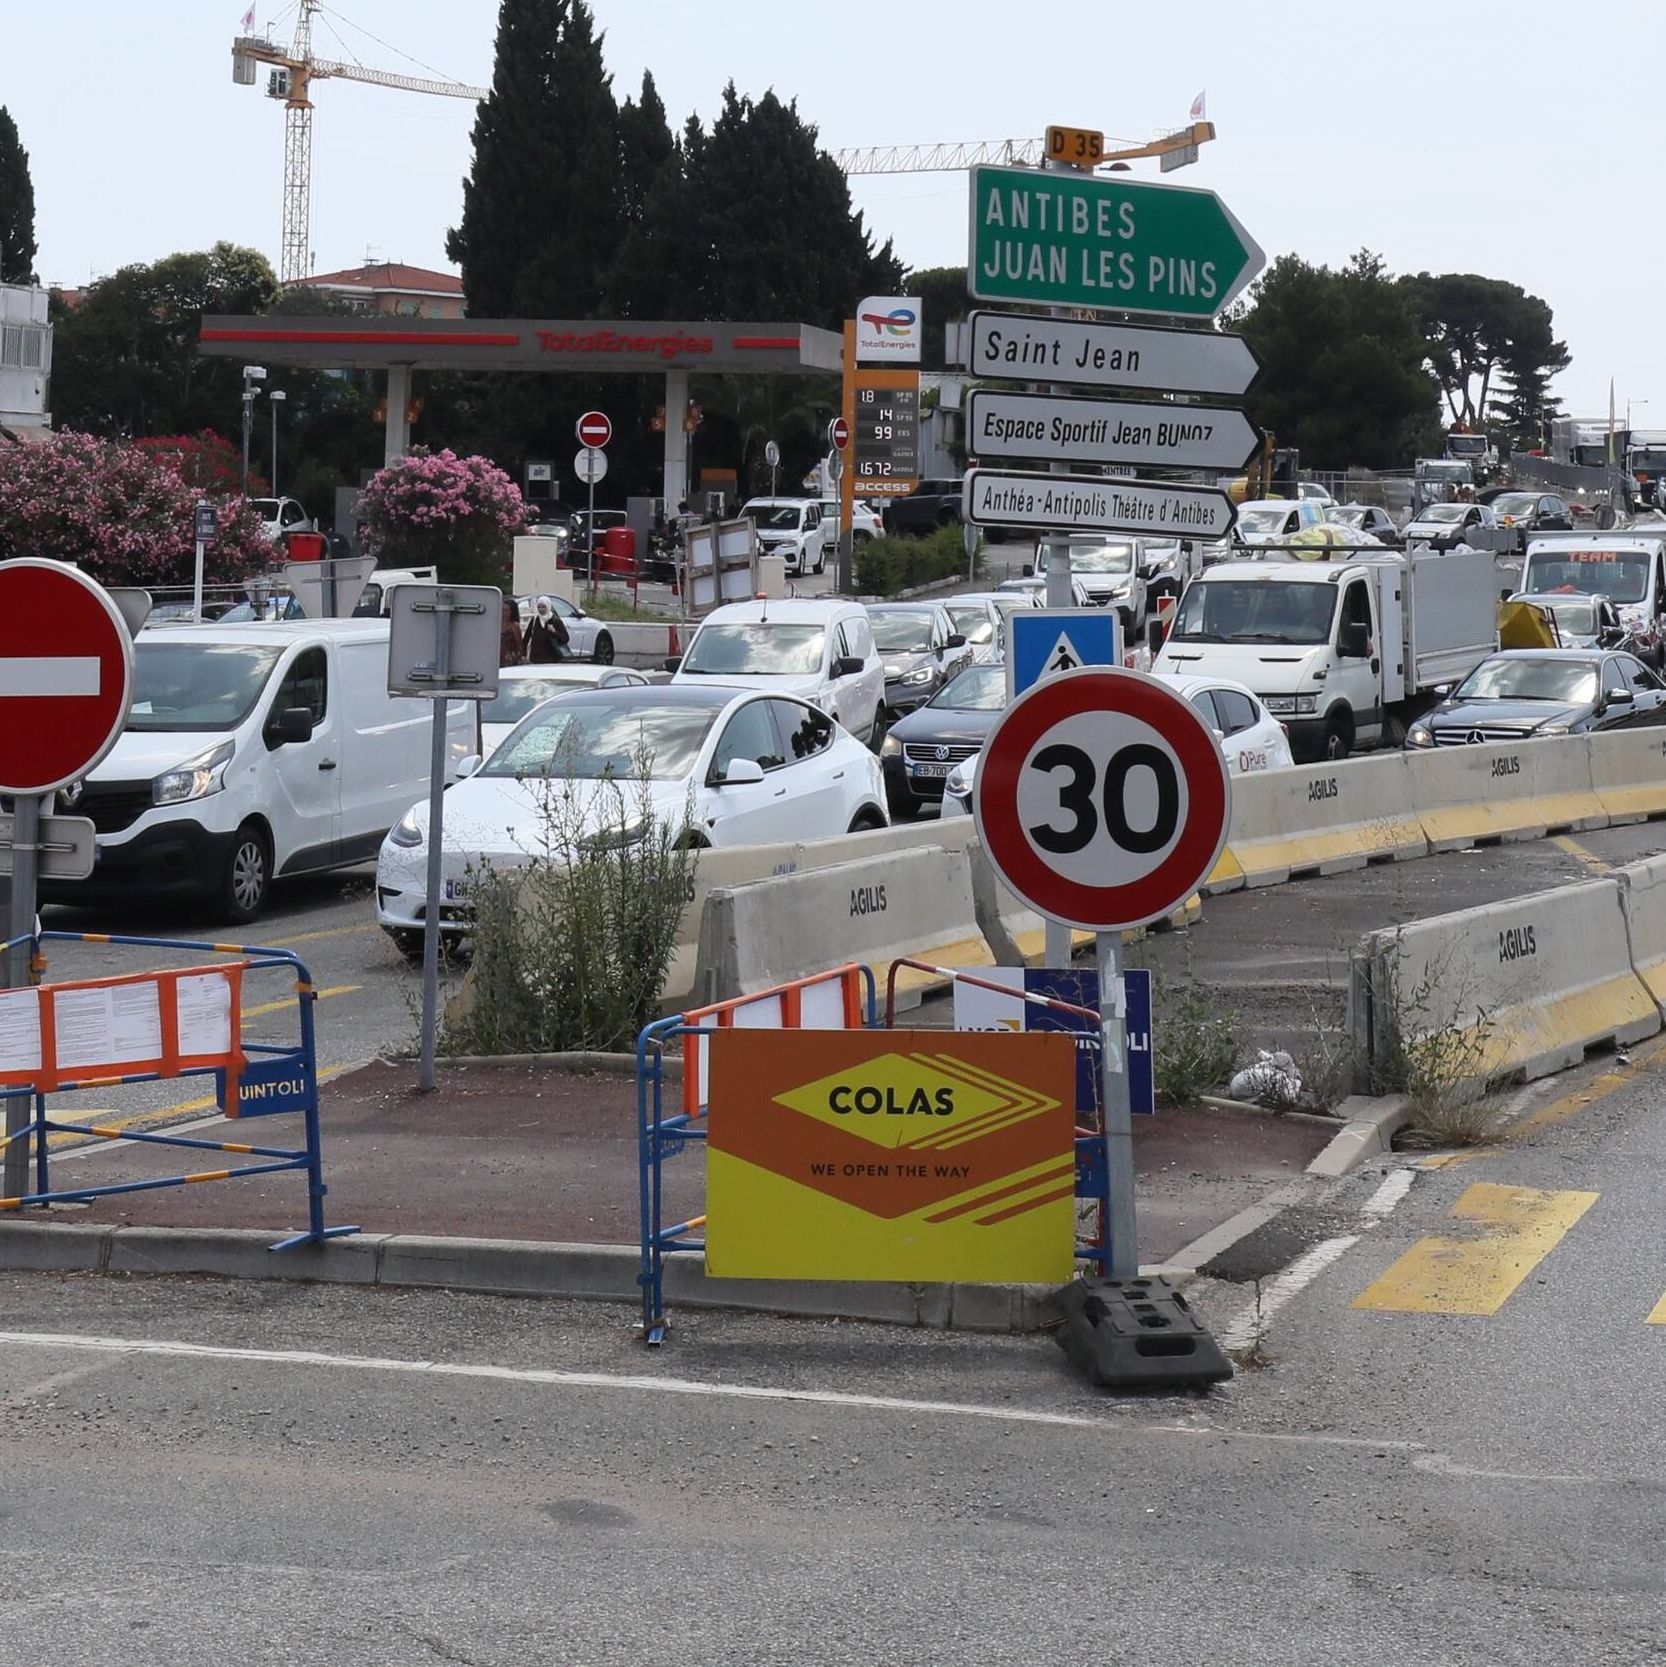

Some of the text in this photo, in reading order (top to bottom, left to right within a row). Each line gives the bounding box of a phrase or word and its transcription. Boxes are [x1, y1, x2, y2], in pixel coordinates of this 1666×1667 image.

[1052, 132, 1100, 158] D 35
[986, 188, 1135, 239] ANTIBES
[984, 240, 1216, 298] JUAN LES PINS
[537, 330, 713, 359] TotalEnergies
[861, 340, 916, 350] TotalEnergies
[985, 330, 1140, 372] Saint Jean
[984, 412, 1045, 443] Espace
[1051, 417, 1108, 447] Sportif
[1112, 421, 1151, 445] Jean
[855, 483, 910, 492] access
[983, 486, 1034, 513] Anthéa
[1043, 490, 1106, 522] Antipolis
[1113, 494, 1154, 522] Théâtre
[1567, 551, 1617, 563] TEAM
[1491, 755, 1520, 778] AGILIS
[1029, 743, 1179, 854] 30
[1309, 778, 1338, 802] AGILIS
[850, 885, 887, 917] AGILIS
[1499, 925, 1536, 963] AGILIS
[239, 1078, 304, 1101] UINTOLI
[828, 1086, 954, 1116] COLAS
[811, 1164, 970, 1178] WE OPEN THE WAY
